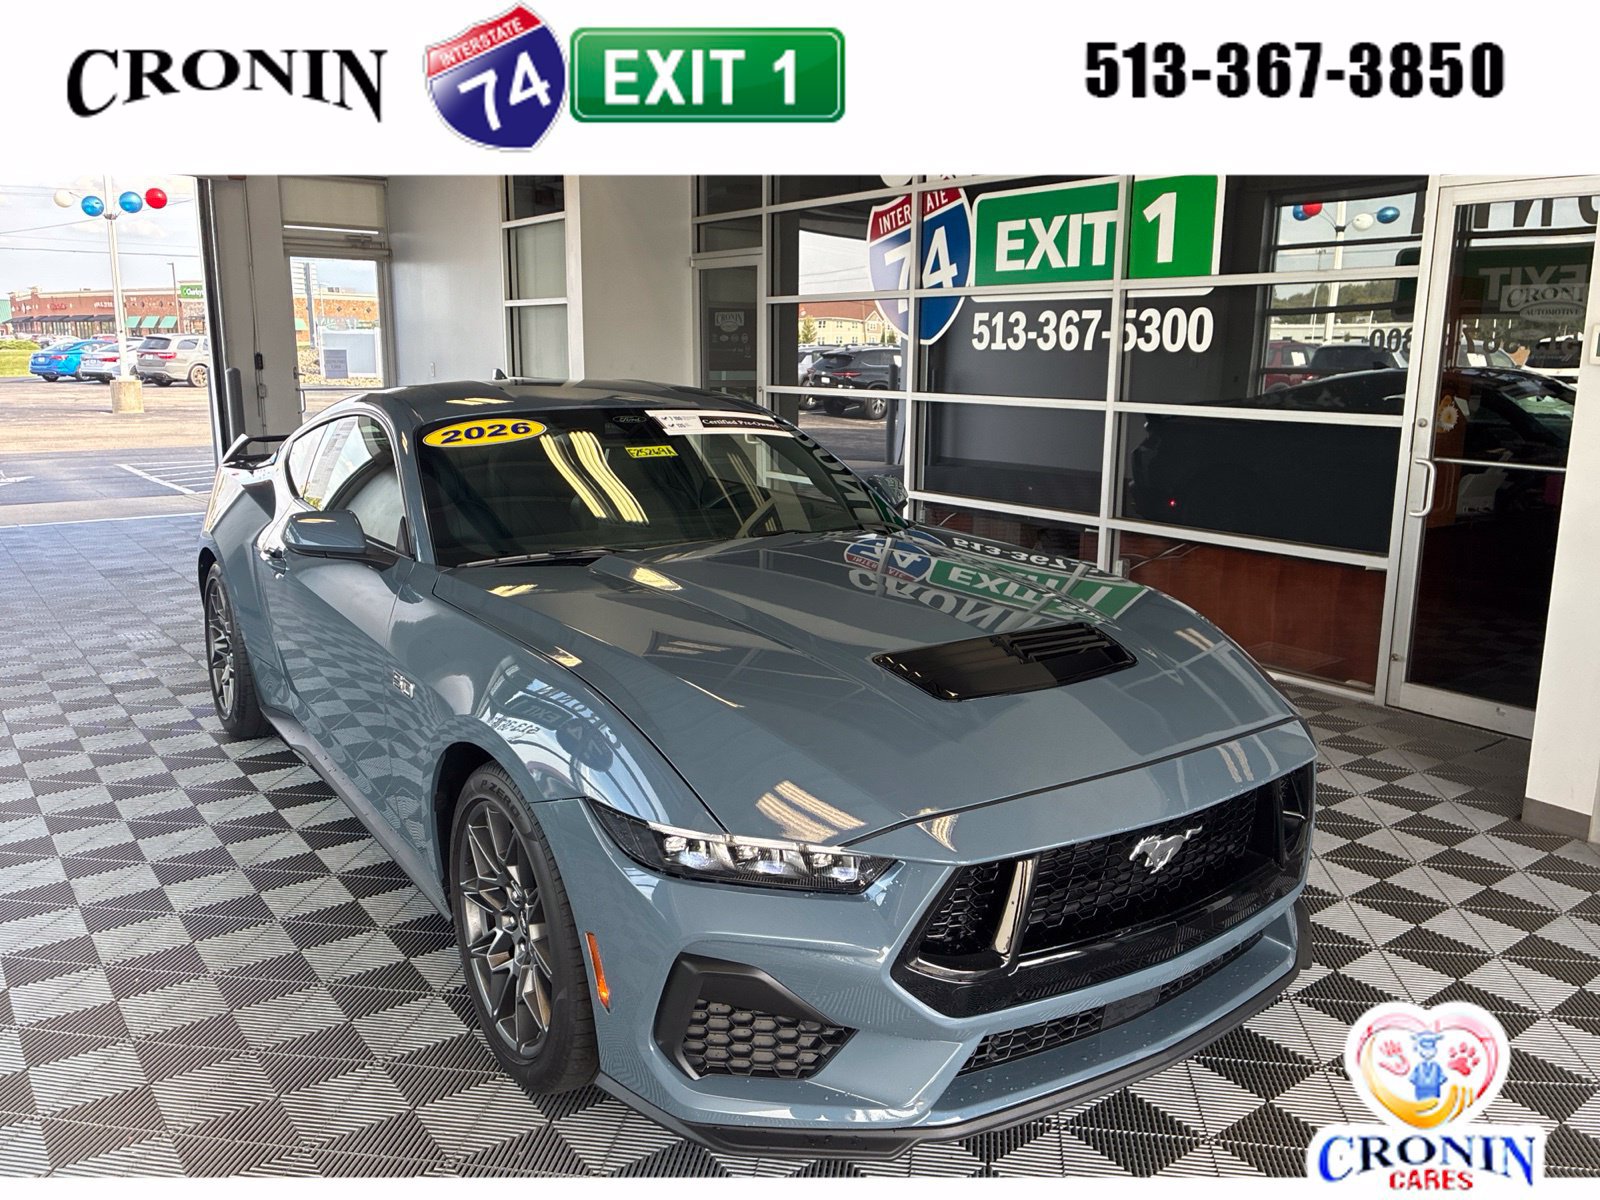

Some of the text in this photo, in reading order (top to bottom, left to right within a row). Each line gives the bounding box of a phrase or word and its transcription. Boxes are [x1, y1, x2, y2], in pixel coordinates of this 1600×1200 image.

[879, 191, 949, 234] INTERATE
[995, 192, 1177, 272] EXIT 1
[1507, 286, 1587, 308] CRONI
[971, 306, 1214, 353] 513-367-5300
[441, 422, 531, 444] 2026
[702, 418, 738, 427] Certified
